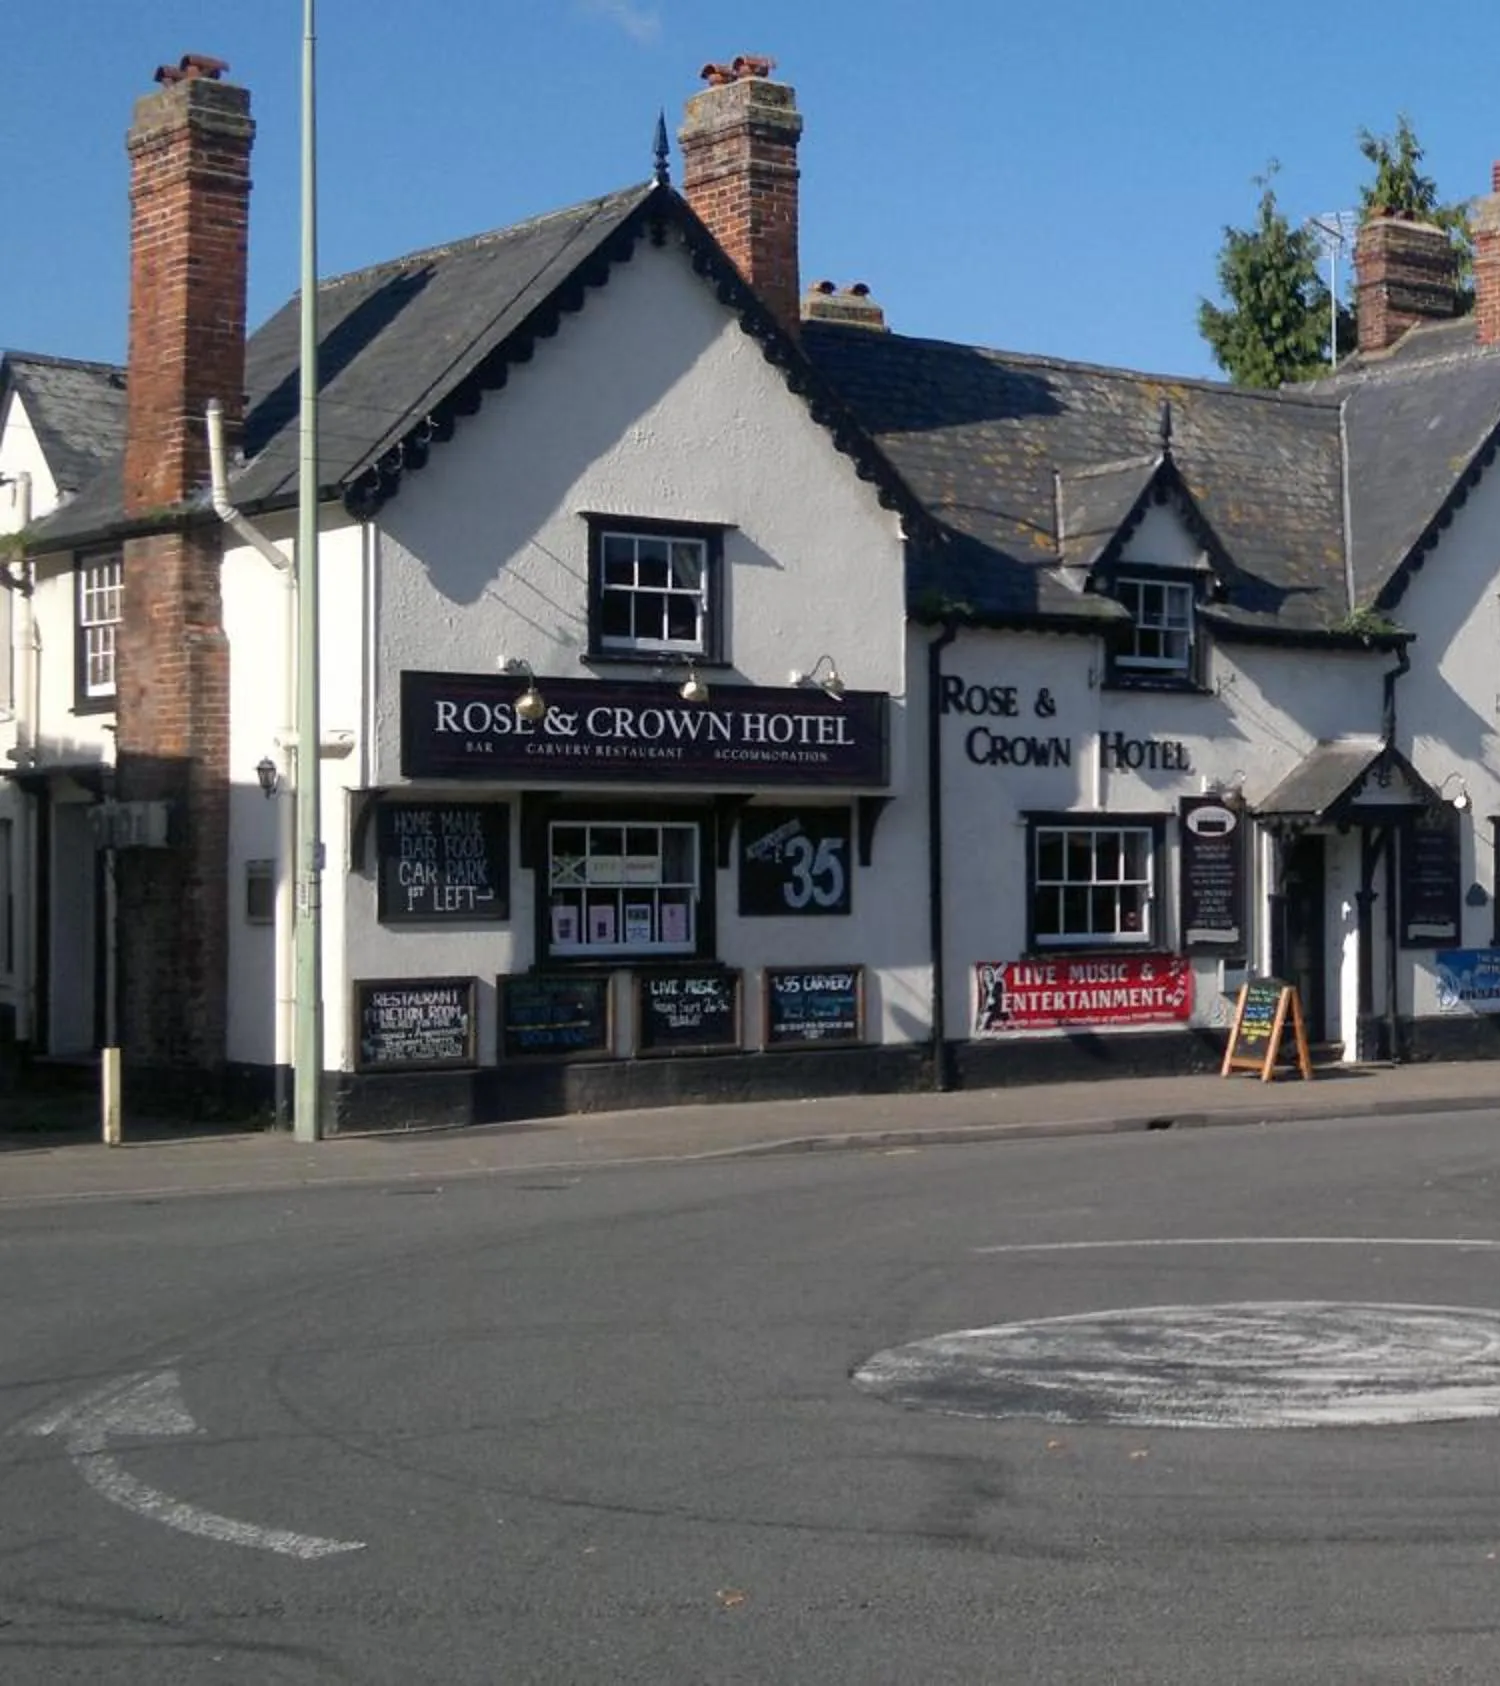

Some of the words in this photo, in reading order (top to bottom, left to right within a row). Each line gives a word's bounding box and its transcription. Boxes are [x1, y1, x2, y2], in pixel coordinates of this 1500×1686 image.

[940, 675, 1018, 717] ROSE
[1034, 687, 1057, 718] &
[435, 701, 536, 735] ROSE
[543, 706, 579, 736] &
[586, 707, 733, 741] CROWN
[741, 713, 855, 745] HOTEL
[465, 740, 494, 753] BAR
[527, 742, 590, 756] CARVERY
[595, 745, 683, 760] RESTAURANT
[714, 748, 828, 763] ACCOMMODATION
[965, 726, 1071, 767] CROWN
[1099, 731, 1191, 770] HOTEL
[394, 811, 433, 835] HOME
[401, 836, 437, 859] BAR
[444, 835, 485, 859] FOOD
[399, 860, 438, 886] CAR
[446, 859, 488, 885] PARK
[433, 885, 477, 911] LEFT
[803, 973, 854, 992] CARVERY
[1013, 965, 1057, 986] LIVE
[1068, 963, 1129, 985] MUSIC
[1140, 963, 1154, 981] &
[372, 989, 458, 1007] RESTAURANT
[650, 979, 679, 995] LIVE
[1002, 987, 1167, 1012] ENTERTAINMENT
